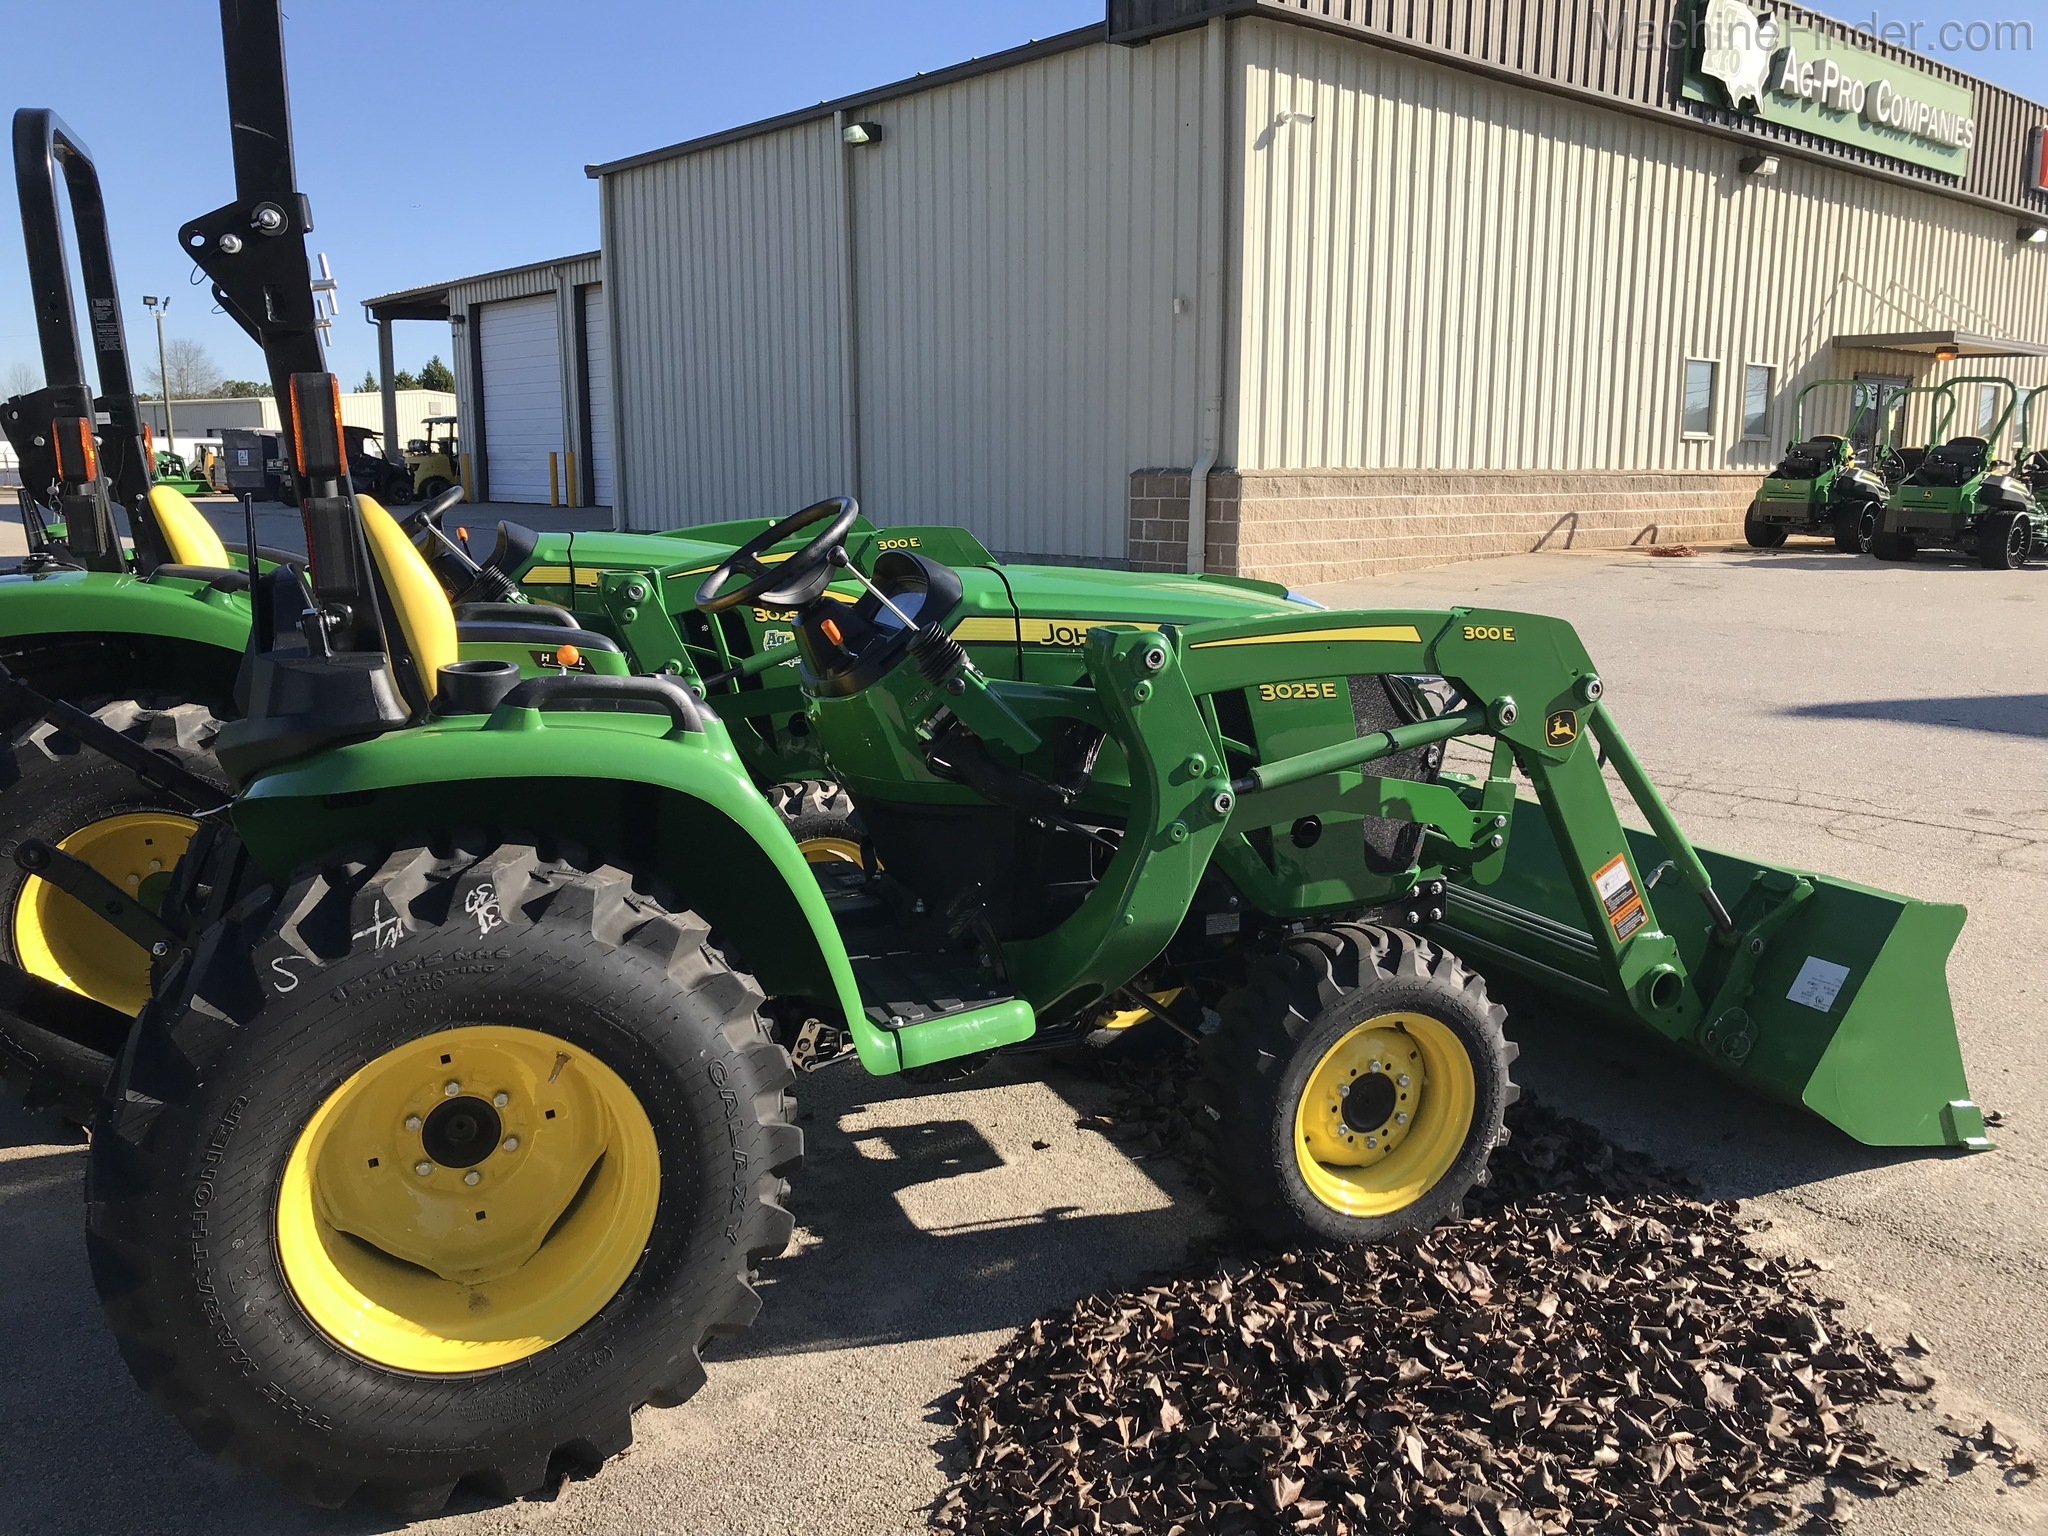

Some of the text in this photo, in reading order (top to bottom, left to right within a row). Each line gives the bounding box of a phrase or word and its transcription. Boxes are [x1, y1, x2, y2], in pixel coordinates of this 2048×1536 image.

[1041, 623, 1090, 644] JOH
[541, 653, 586, 667] H L
[709, 1059, 749, 1246] GALAXY
